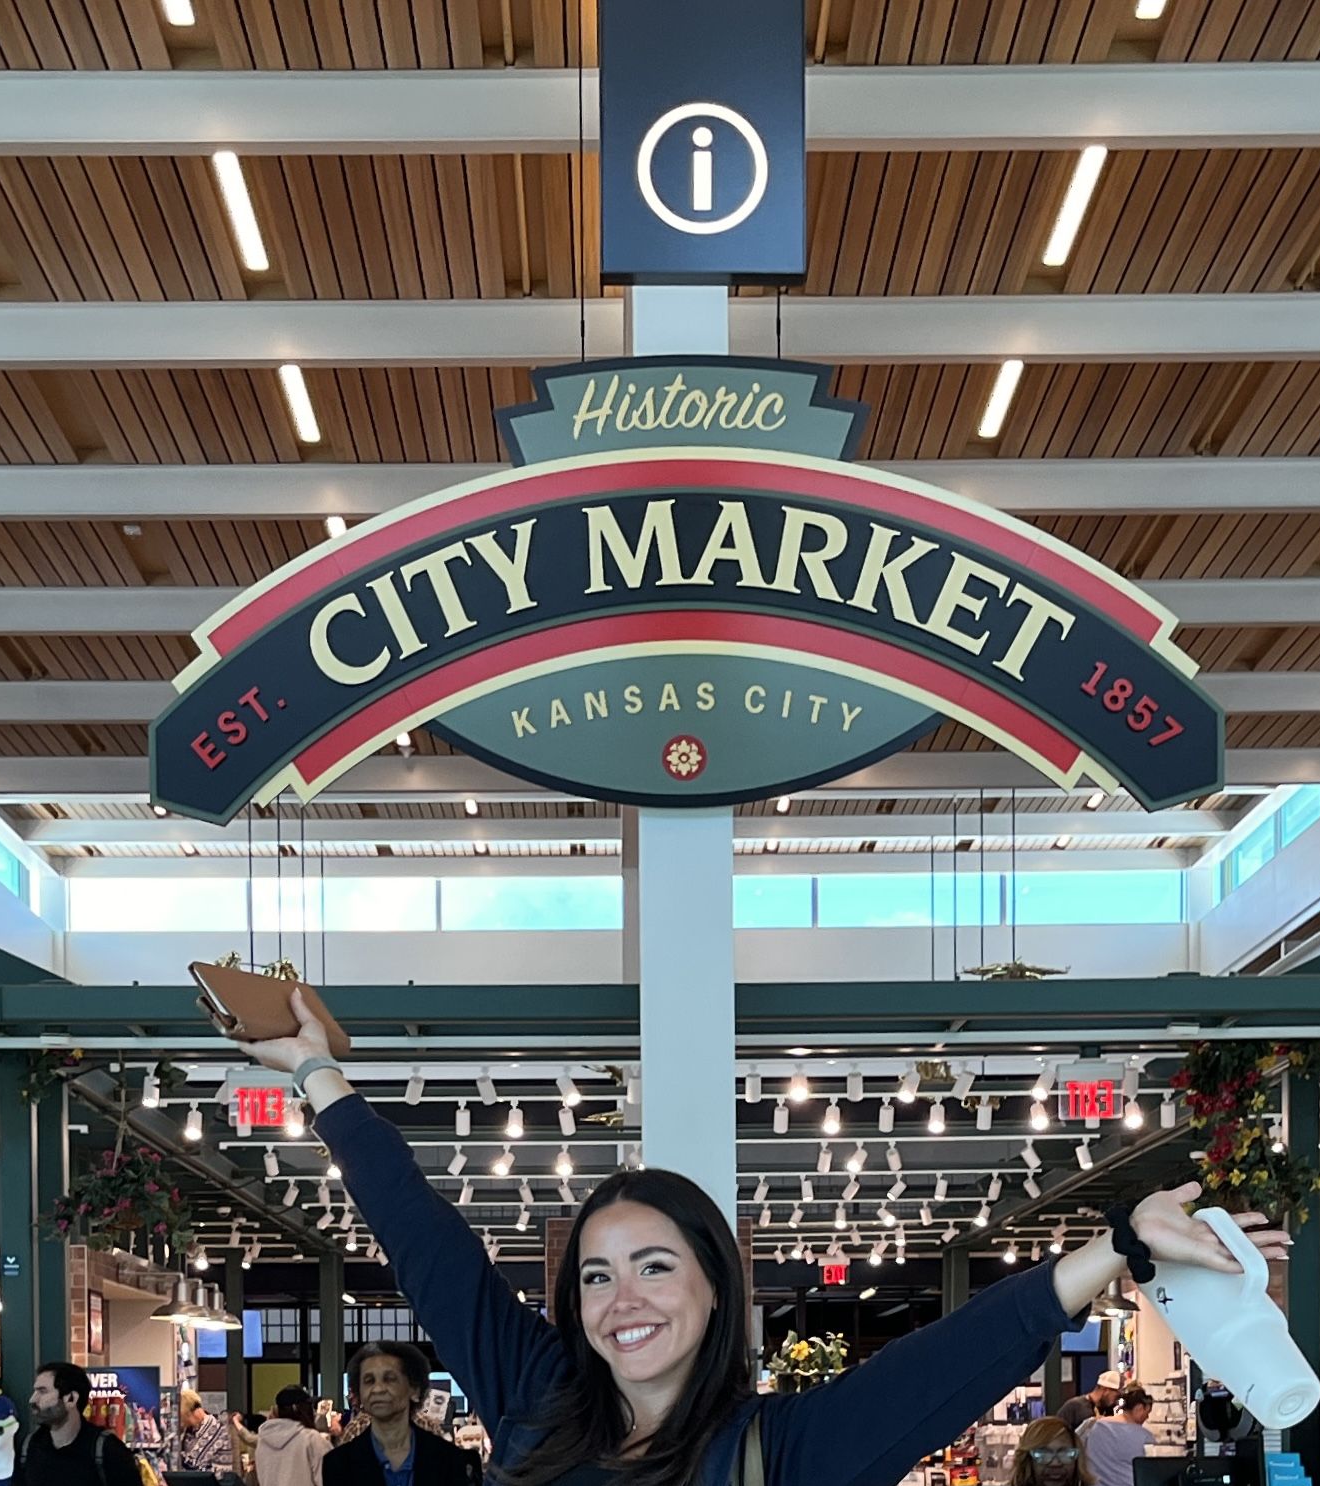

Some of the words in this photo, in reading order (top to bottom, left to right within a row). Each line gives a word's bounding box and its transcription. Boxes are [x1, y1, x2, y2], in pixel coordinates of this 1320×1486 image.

[572, 373, 786, 439] Historic
[309, 518, 539, 686] CITY
[582, 499, 1076, 682] MARKET
[190, 685, 288, 770] EST.
[510, 682, 717, 738] KANSAS
[743, 684, 864, 734] CITY
[1080, 661, 1185, 748] 1857
